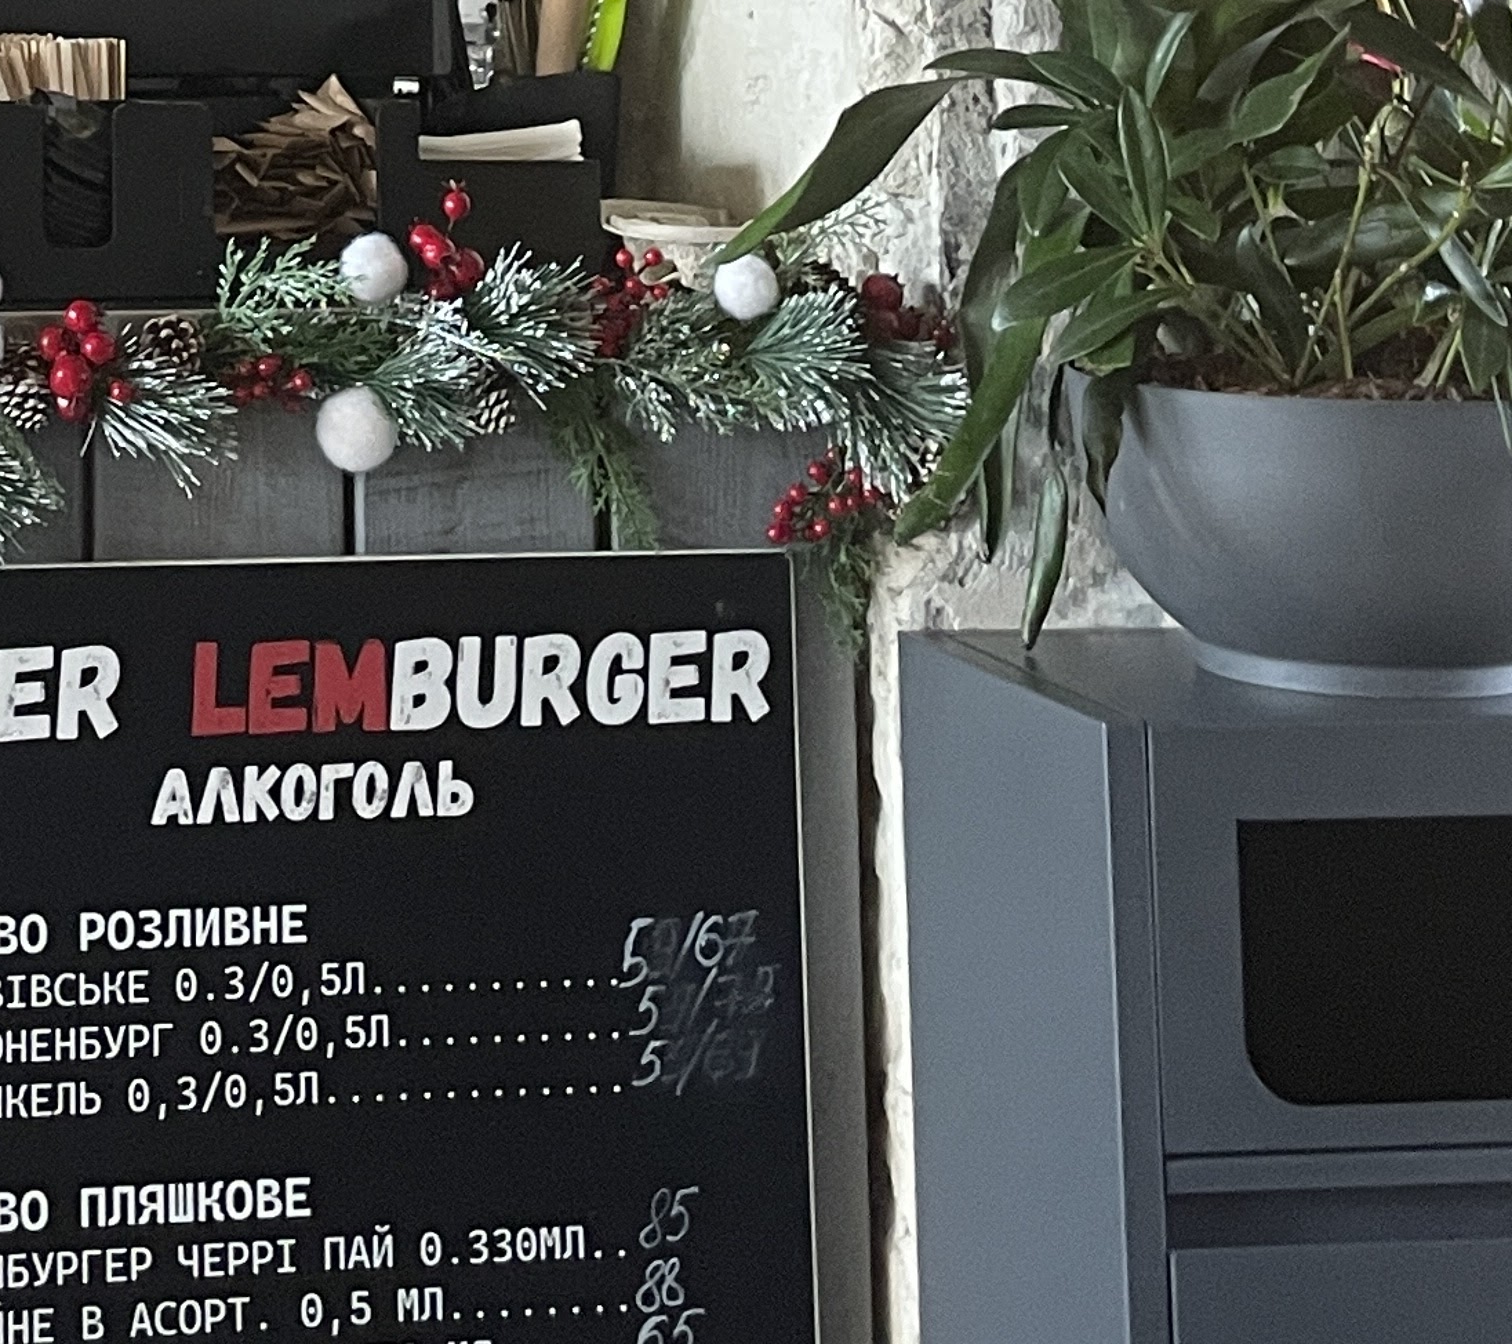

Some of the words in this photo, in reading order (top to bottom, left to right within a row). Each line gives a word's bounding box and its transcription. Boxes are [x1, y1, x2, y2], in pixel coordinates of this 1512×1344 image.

[190, 629, 771, 736] LEMBURGER
[151, 760, 473, 825] АЛКОГОЛЬ
[80, 904, 307, 951] РОЗЛИВНЕ
[176, 961, 364, 1006] 0.3/0,5Л
[200, 1014, 389, 1058] 0.3/0,5Л
[128, 1071, 318, 1120] 0,3/0,5Л
[81, 1177, 311, 1228] ПЛЯШКОВЕ
[178, 1239, 296, 1278] ЧЕРРІ
[324, 1225, 393, 1270] ПАЙ
[421, 1226, 584, 1266] 0.330МЛ
[639, 1186, 699, 1249] 85
[82, 1306, 104, 1340] В
[130, 1297, 267, 1337] АСОРТ.
[301, 1291, 371, 1336] 0,5
[398, 1287, 443, 1322] МЛ
[636, 1257, 684, 1313] 88
